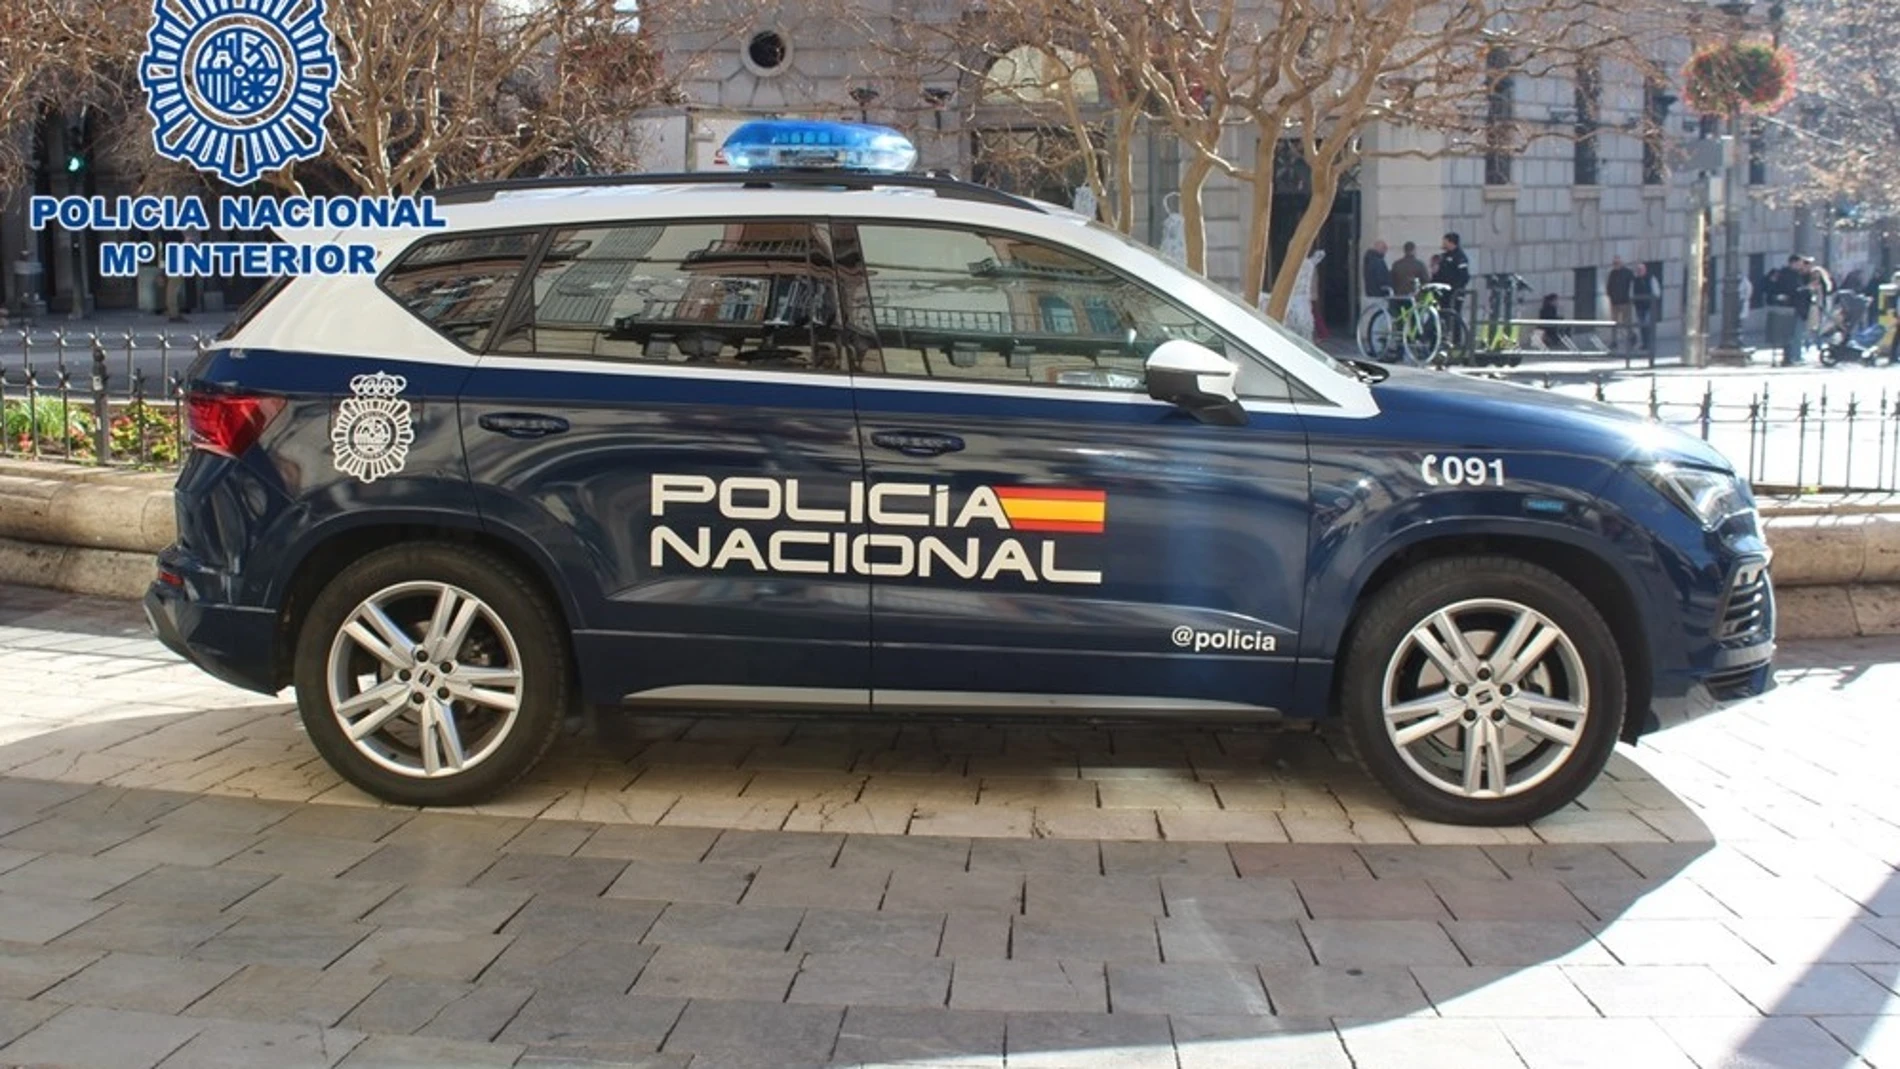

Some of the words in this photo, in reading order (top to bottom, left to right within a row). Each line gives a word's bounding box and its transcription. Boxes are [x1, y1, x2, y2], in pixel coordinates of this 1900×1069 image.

[1442, 455, 1504, 487] 091
[651, 526, 1102, 584] NACIONAL
[1171, 625, 1277, 652] @policia
